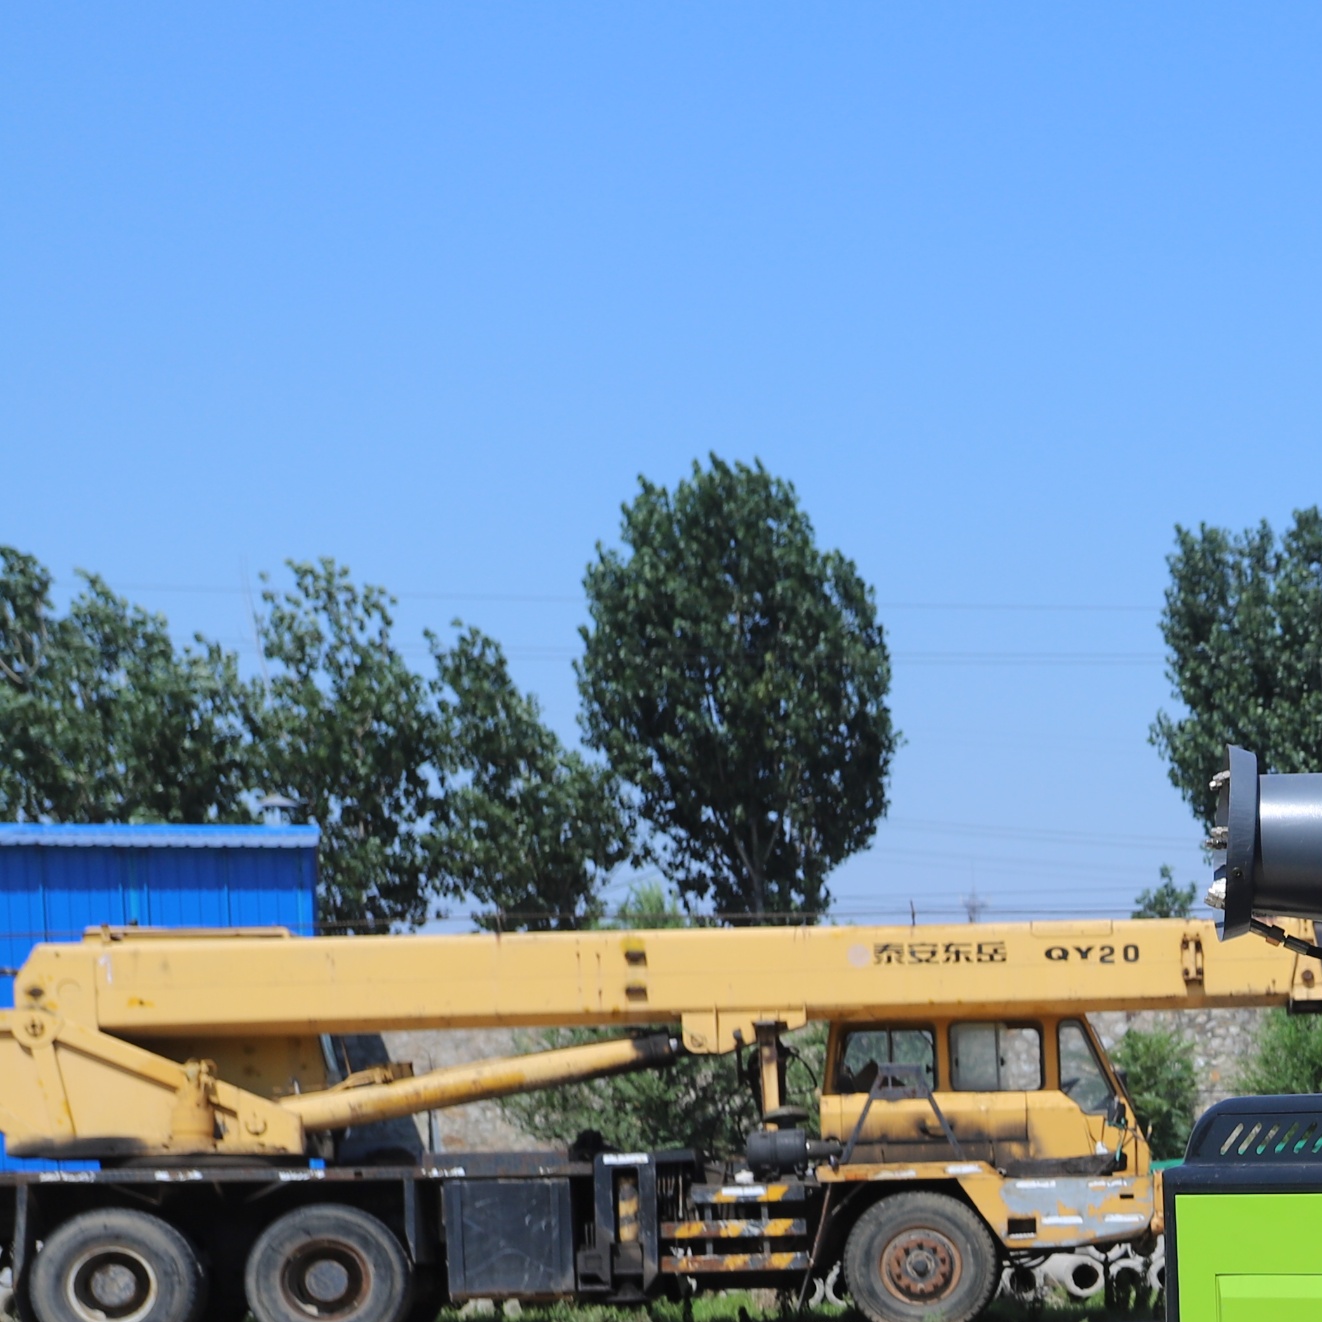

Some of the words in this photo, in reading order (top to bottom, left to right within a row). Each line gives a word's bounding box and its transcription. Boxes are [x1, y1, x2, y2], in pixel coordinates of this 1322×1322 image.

[873, 941, 1007, 965] 泰安东岳
[1044, 944, 1140, 964] QY20
